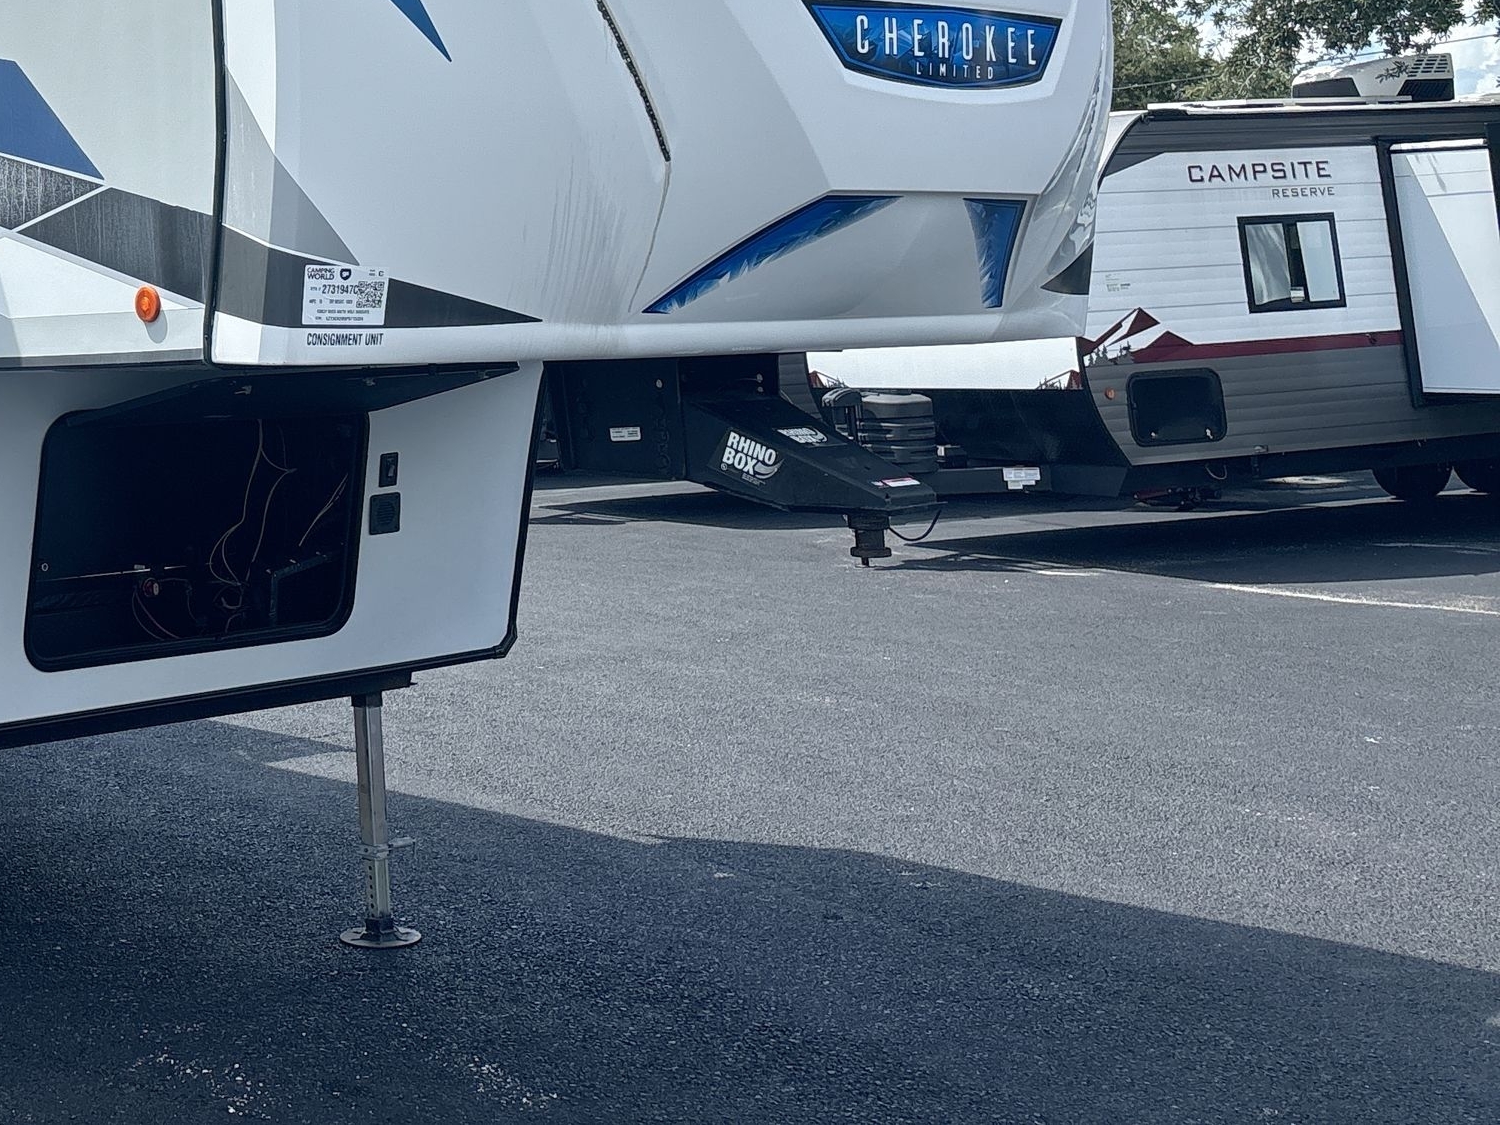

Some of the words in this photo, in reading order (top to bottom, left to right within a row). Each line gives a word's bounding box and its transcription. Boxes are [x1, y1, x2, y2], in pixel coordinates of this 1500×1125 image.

[855, 15, 1037, 65] CHEROKEE
[916, 62, 994, 80] LIMITED
[1187, 160, 1331, 183] CAMPSITE
[1272, 186, 1335, 199] RESERVE
[307, 273, 335, 281] WORLD
[307, 332, 363, 346] CONSIGNMENT
[365, 332, 384, 346] UNIT
[726, 431, 777, 465] RHINO
[722, 446, 758, 475] BOX
